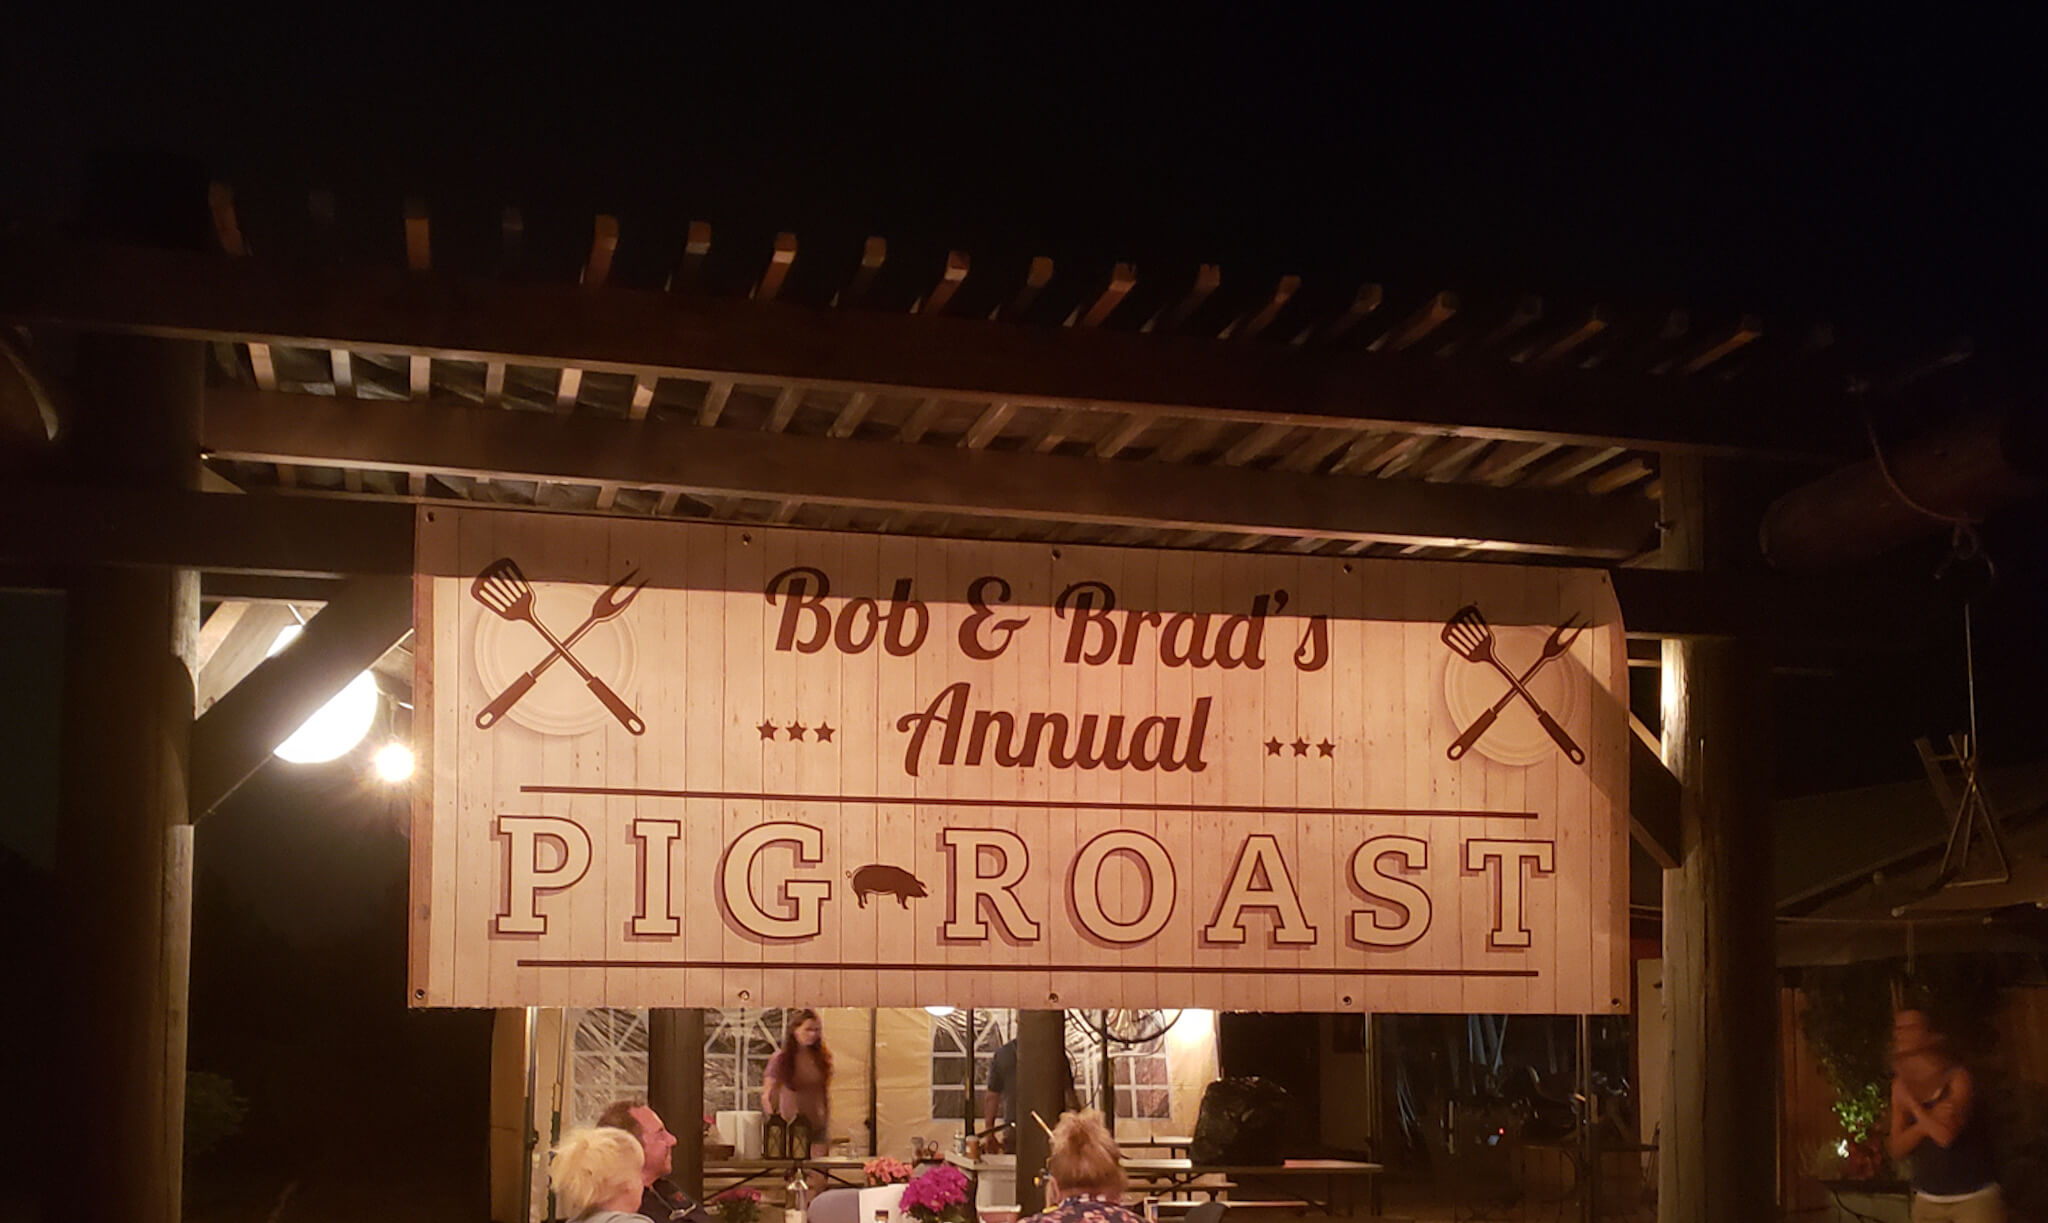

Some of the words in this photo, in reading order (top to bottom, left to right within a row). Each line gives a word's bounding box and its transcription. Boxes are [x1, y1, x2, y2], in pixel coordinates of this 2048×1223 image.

[765, 565, 930, 657] Bob
[958, 575, 1030, 661] &
[1054, 581, 1330, 672] Brad's
[896, 682, 1213, 777] Annual
[488, 815, 832, 943] PIG
[936, 826, 1555, 954] ROAST
